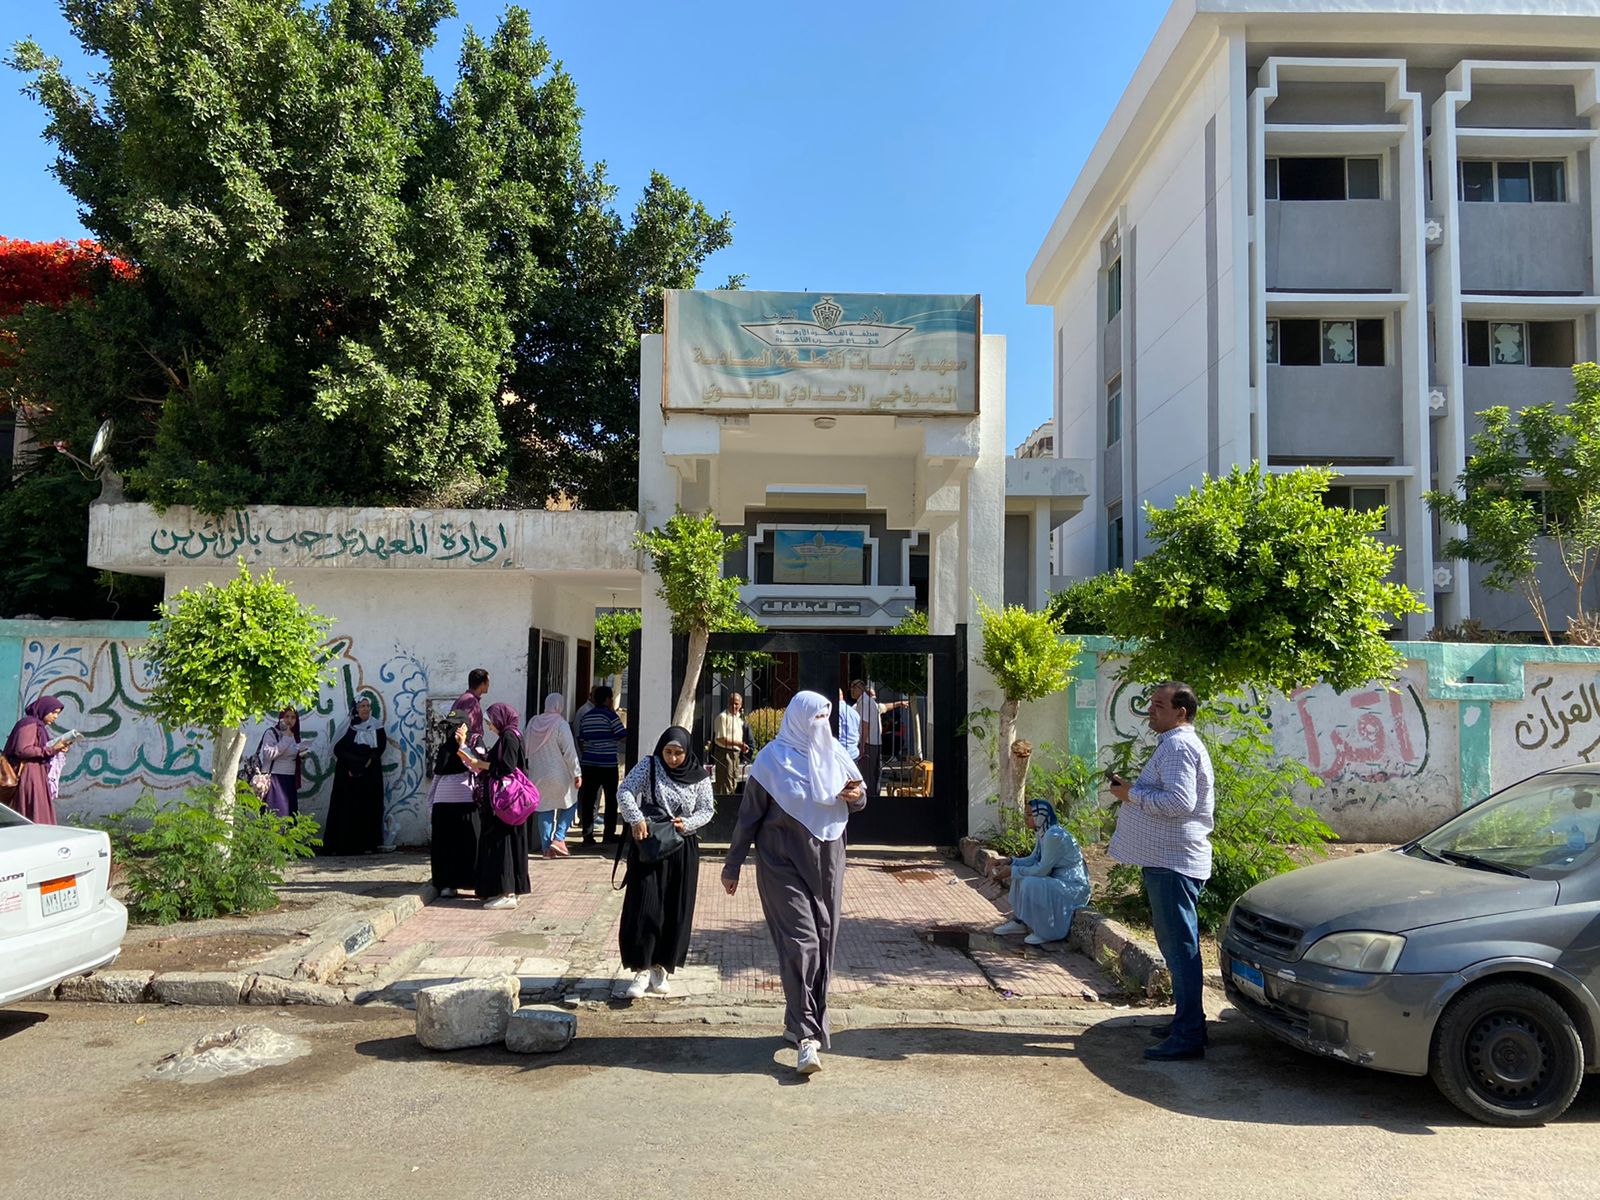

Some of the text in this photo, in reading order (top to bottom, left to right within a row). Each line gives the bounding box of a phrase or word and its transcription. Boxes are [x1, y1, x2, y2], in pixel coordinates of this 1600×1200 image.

[919, 357, 967, 376] معهد
[351, 519, 428, 560] المعهد
[432, 520, 513, 568] إدارة
[58, 722, 213, 784] ظيم
